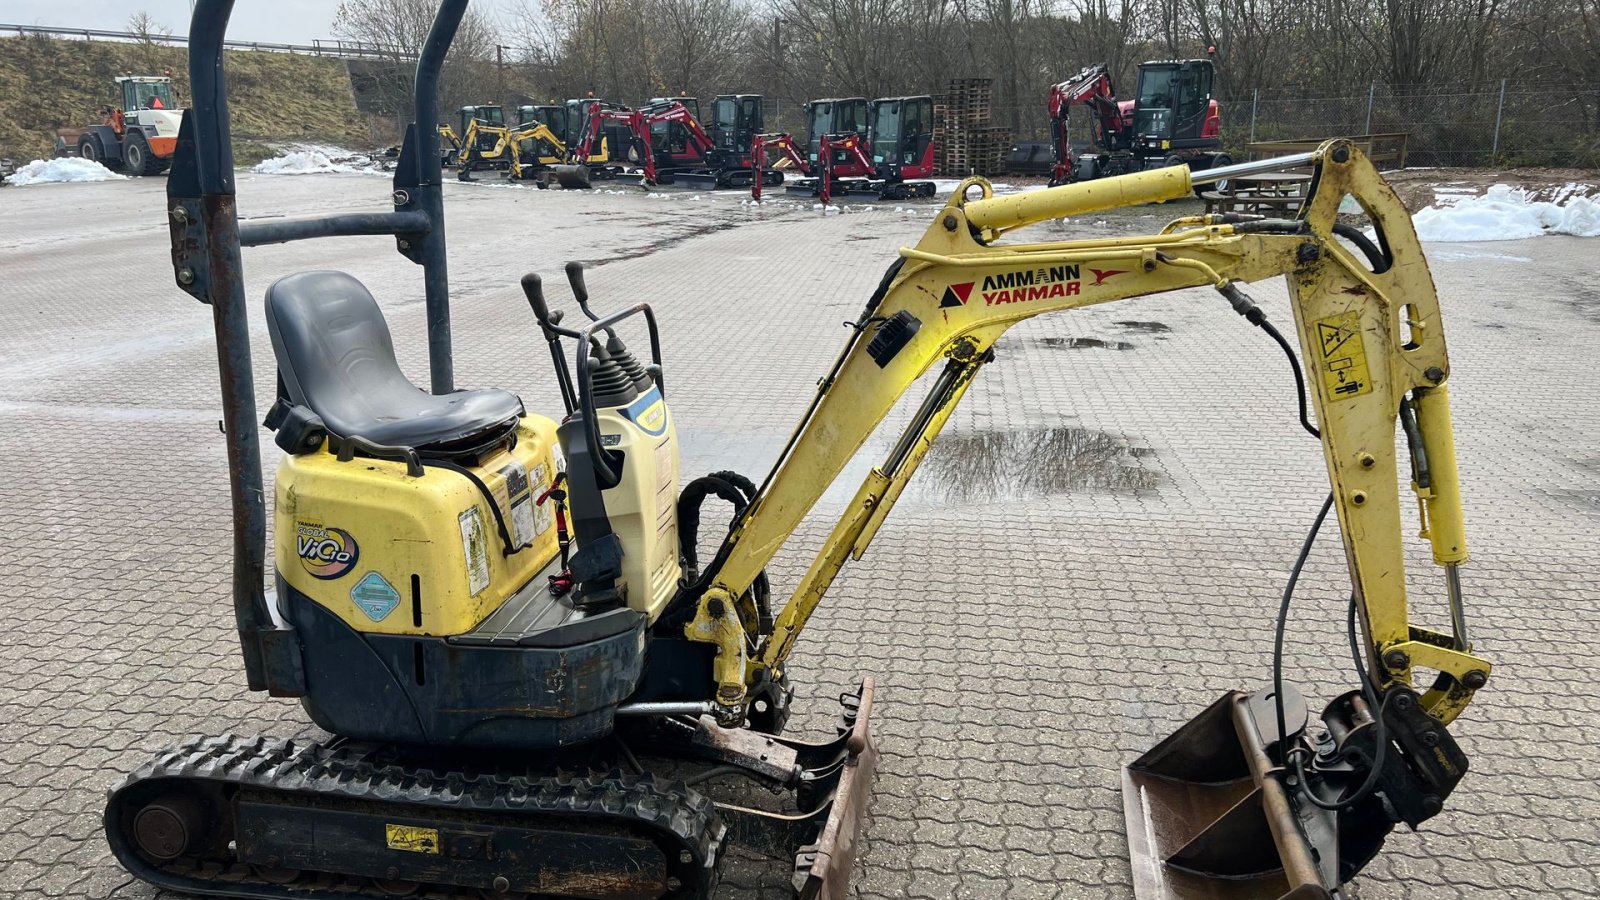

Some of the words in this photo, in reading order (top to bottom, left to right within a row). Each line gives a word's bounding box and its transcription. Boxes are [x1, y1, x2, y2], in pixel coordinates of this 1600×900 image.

[982, 264, 1080, 291] AMMANN
[982, 281, 1080, 306] YANMAR
[298, 527, 329, 538] GLOBAL
